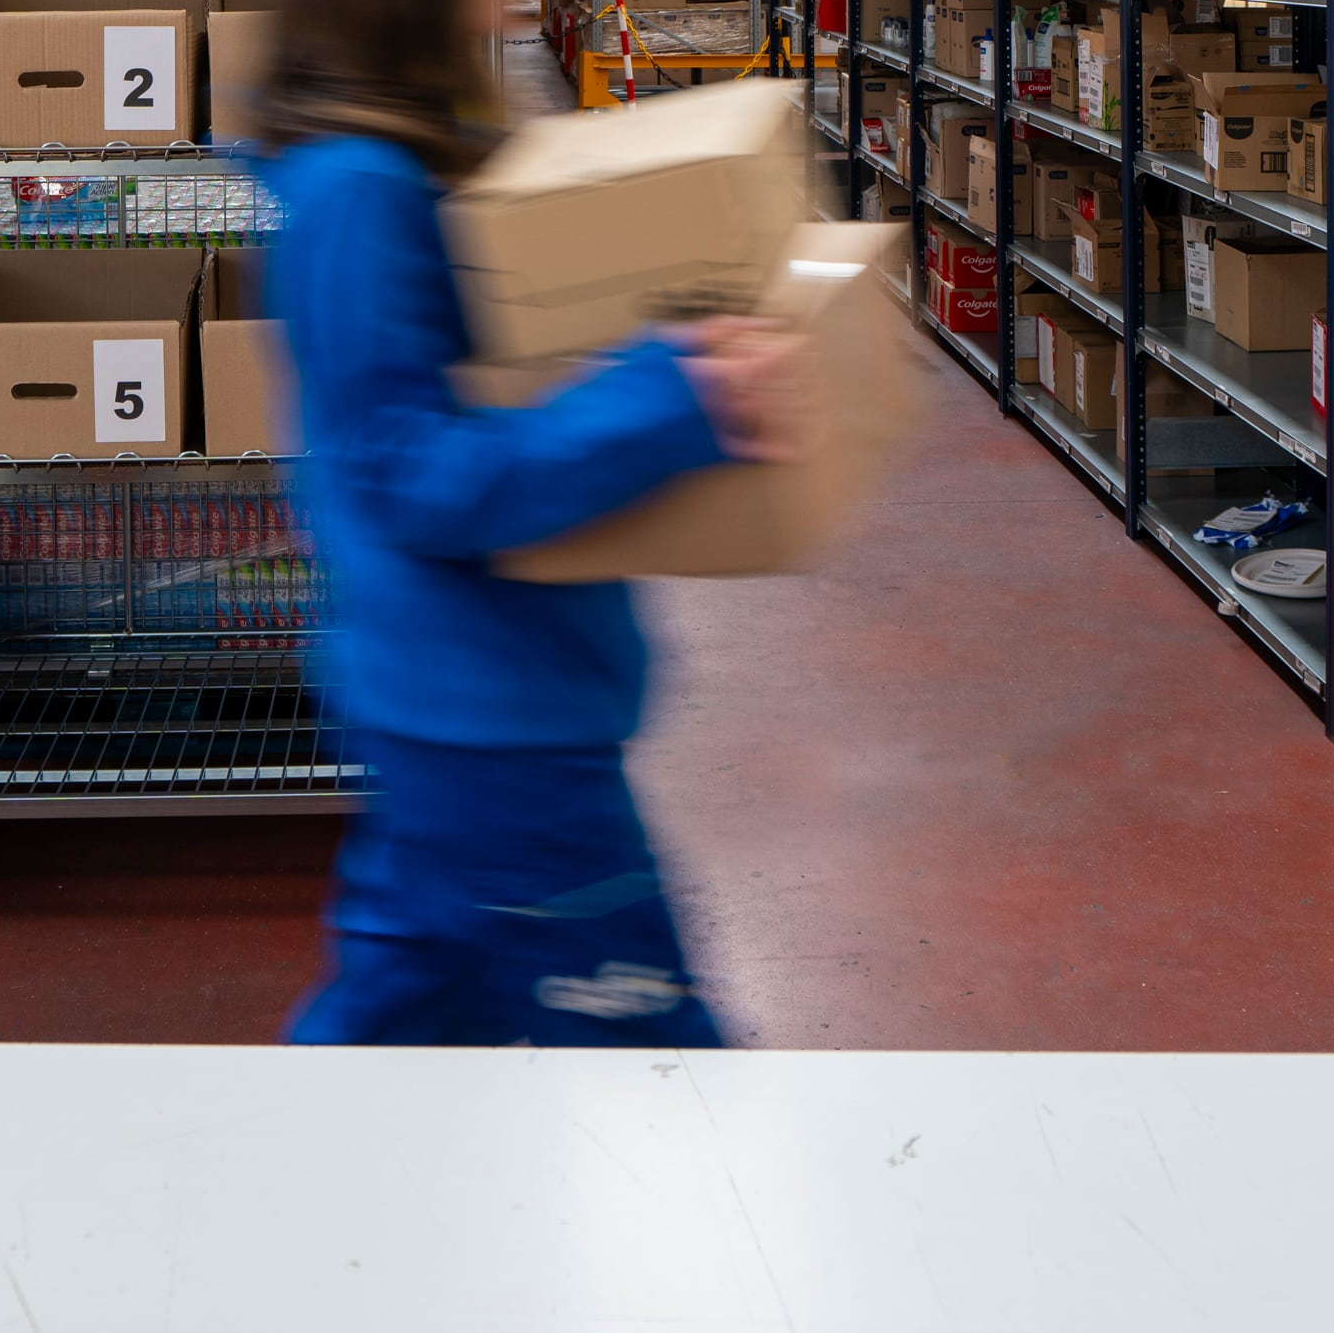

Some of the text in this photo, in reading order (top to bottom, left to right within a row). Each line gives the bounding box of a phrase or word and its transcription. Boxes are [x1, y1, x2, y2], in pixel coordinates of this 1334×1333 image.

[124, 68, 154, 107] 2
[96, 183, 116, 191] Triple
[961, 256, 997, 266] Colgat
[114, 382, 144, 420] 5
